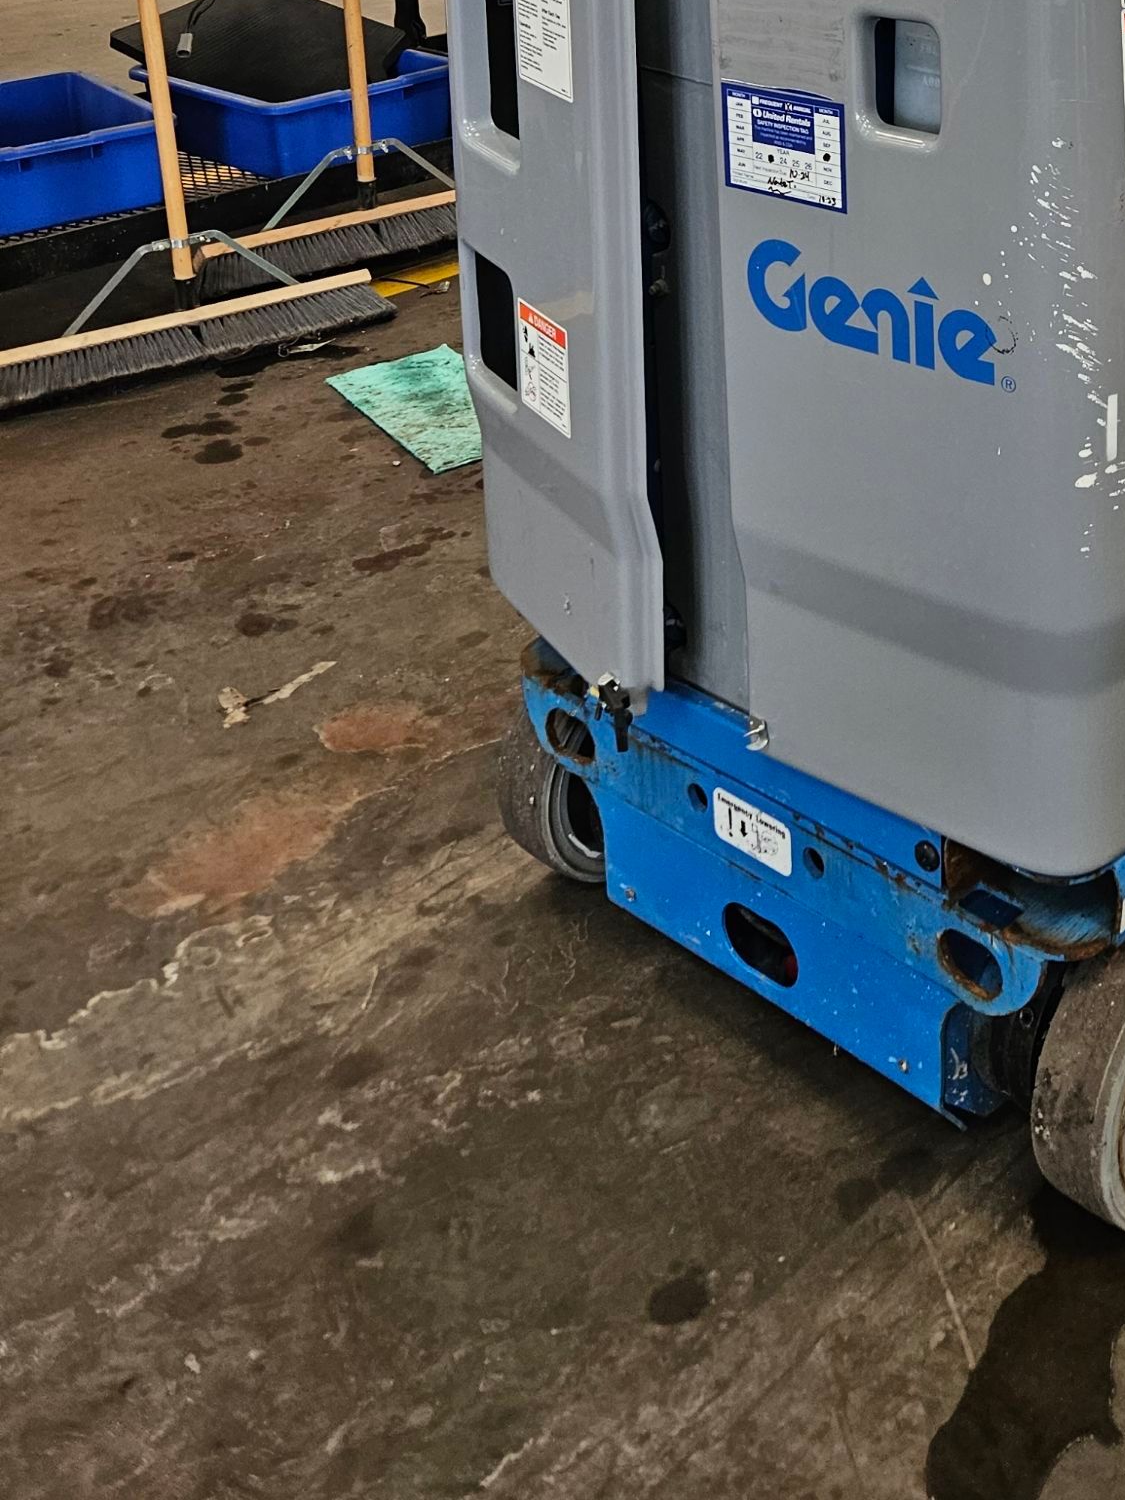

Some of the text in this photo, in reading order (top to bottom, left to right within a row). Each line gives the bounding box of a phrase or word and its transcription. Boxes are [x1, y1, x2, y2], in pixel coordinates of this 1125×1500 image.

[757, 119, 773, 128] SAFETY
[774, 123, 799, 133] INSPECTION
[762, 110, 811, 127] United Rentals
[780, 157, 787, 165] 24
[792, 160, 800, 168] 25
[805, 162, 812, 171] 26
[747, 238, 998, 387] Genie
